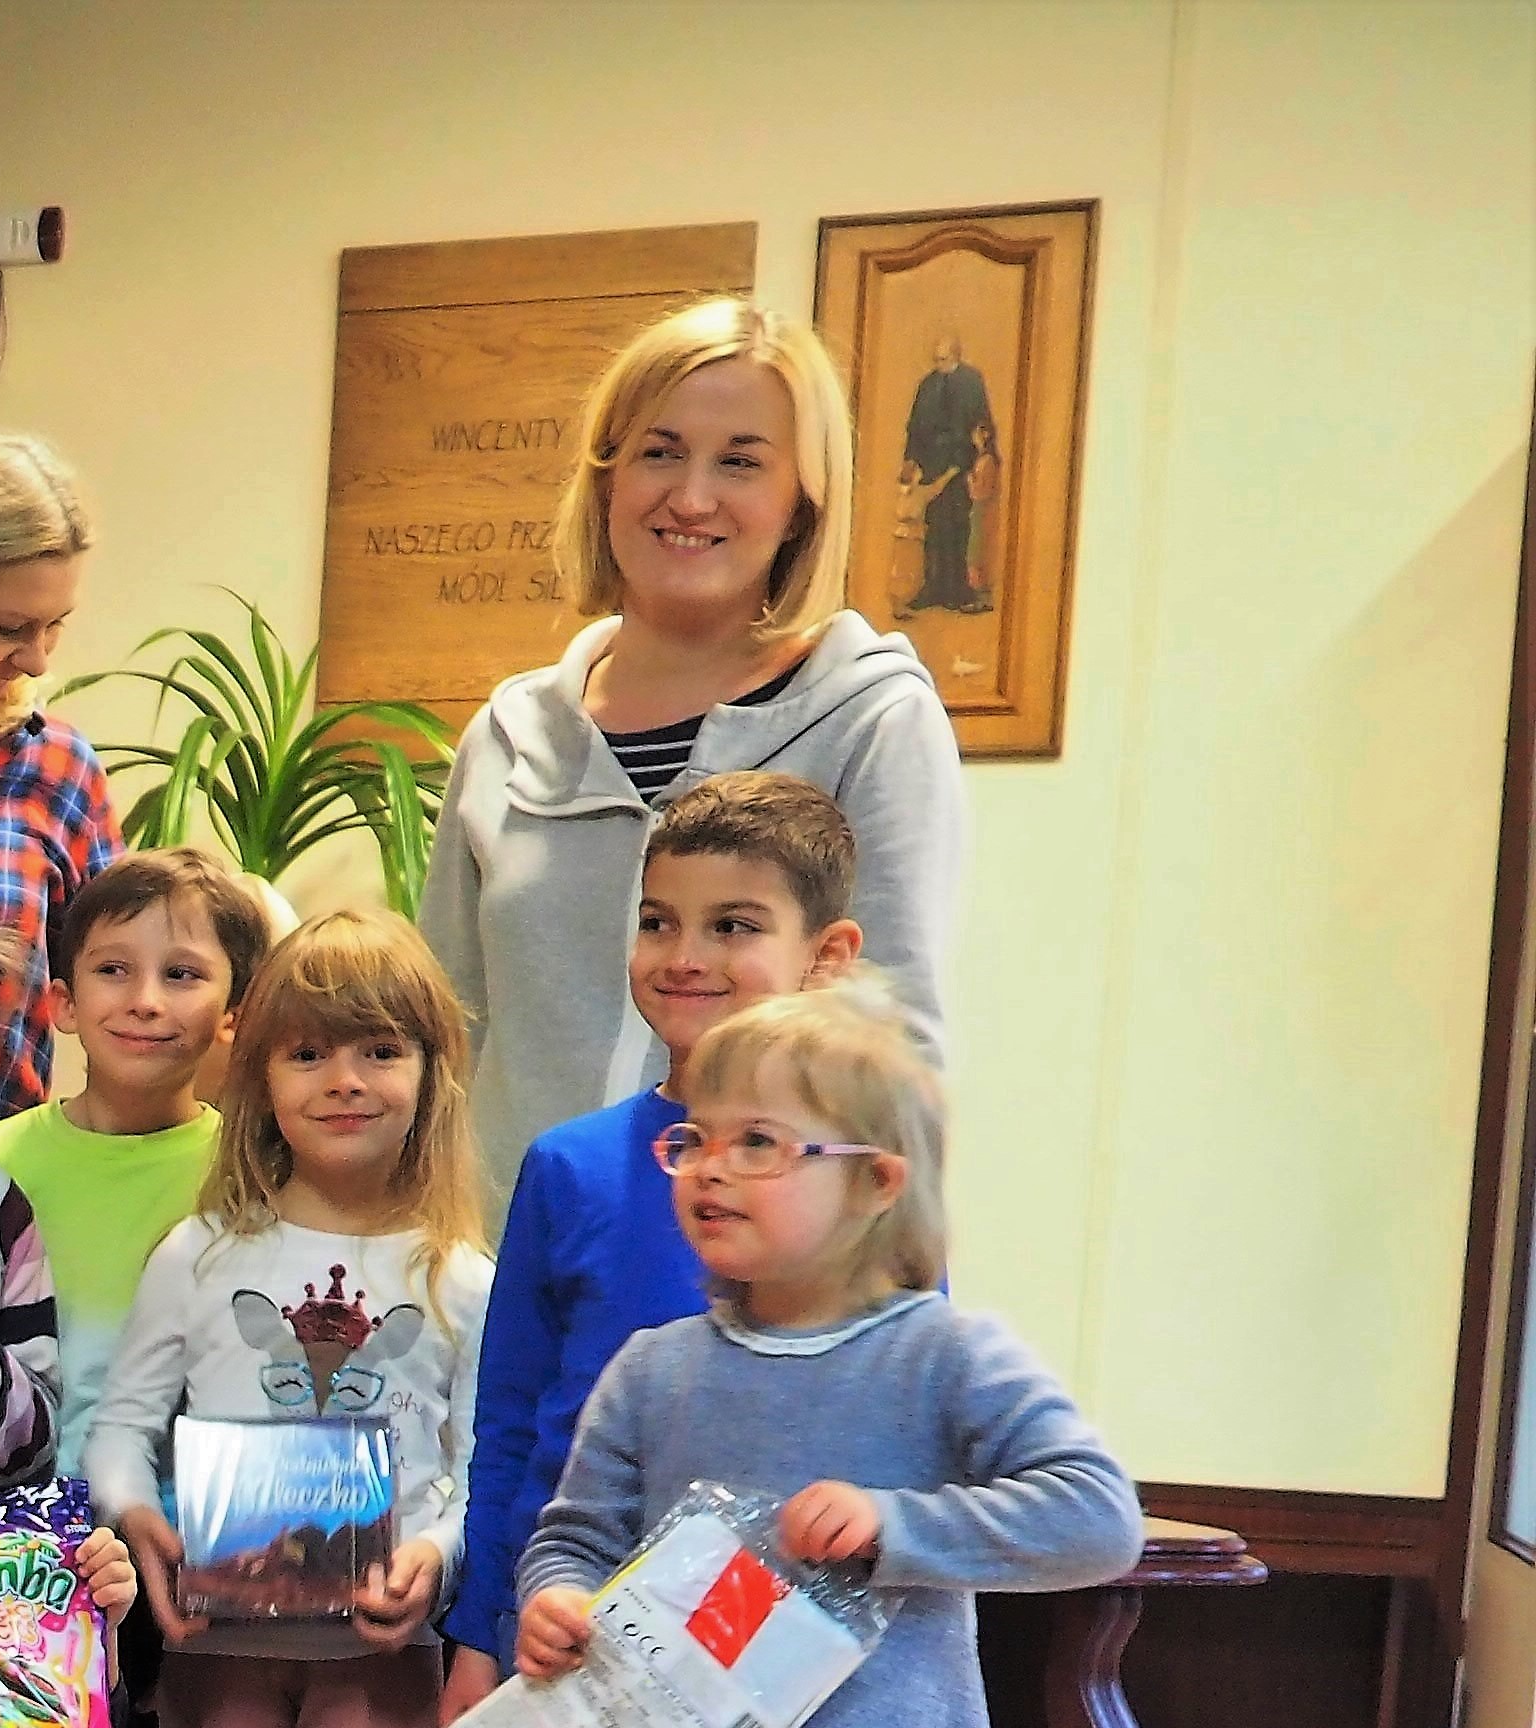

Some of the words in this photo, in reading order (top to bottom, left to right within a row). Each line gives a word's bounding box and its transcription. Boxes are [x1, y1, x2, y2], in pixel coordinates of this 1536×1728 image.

[431, 416, 570, 452] WINCENTY
[365, 521, 496, 555] NASZEGO
[507, 519, 554, 550] PRZ
[437, 560, 506, 604] MÓDL
